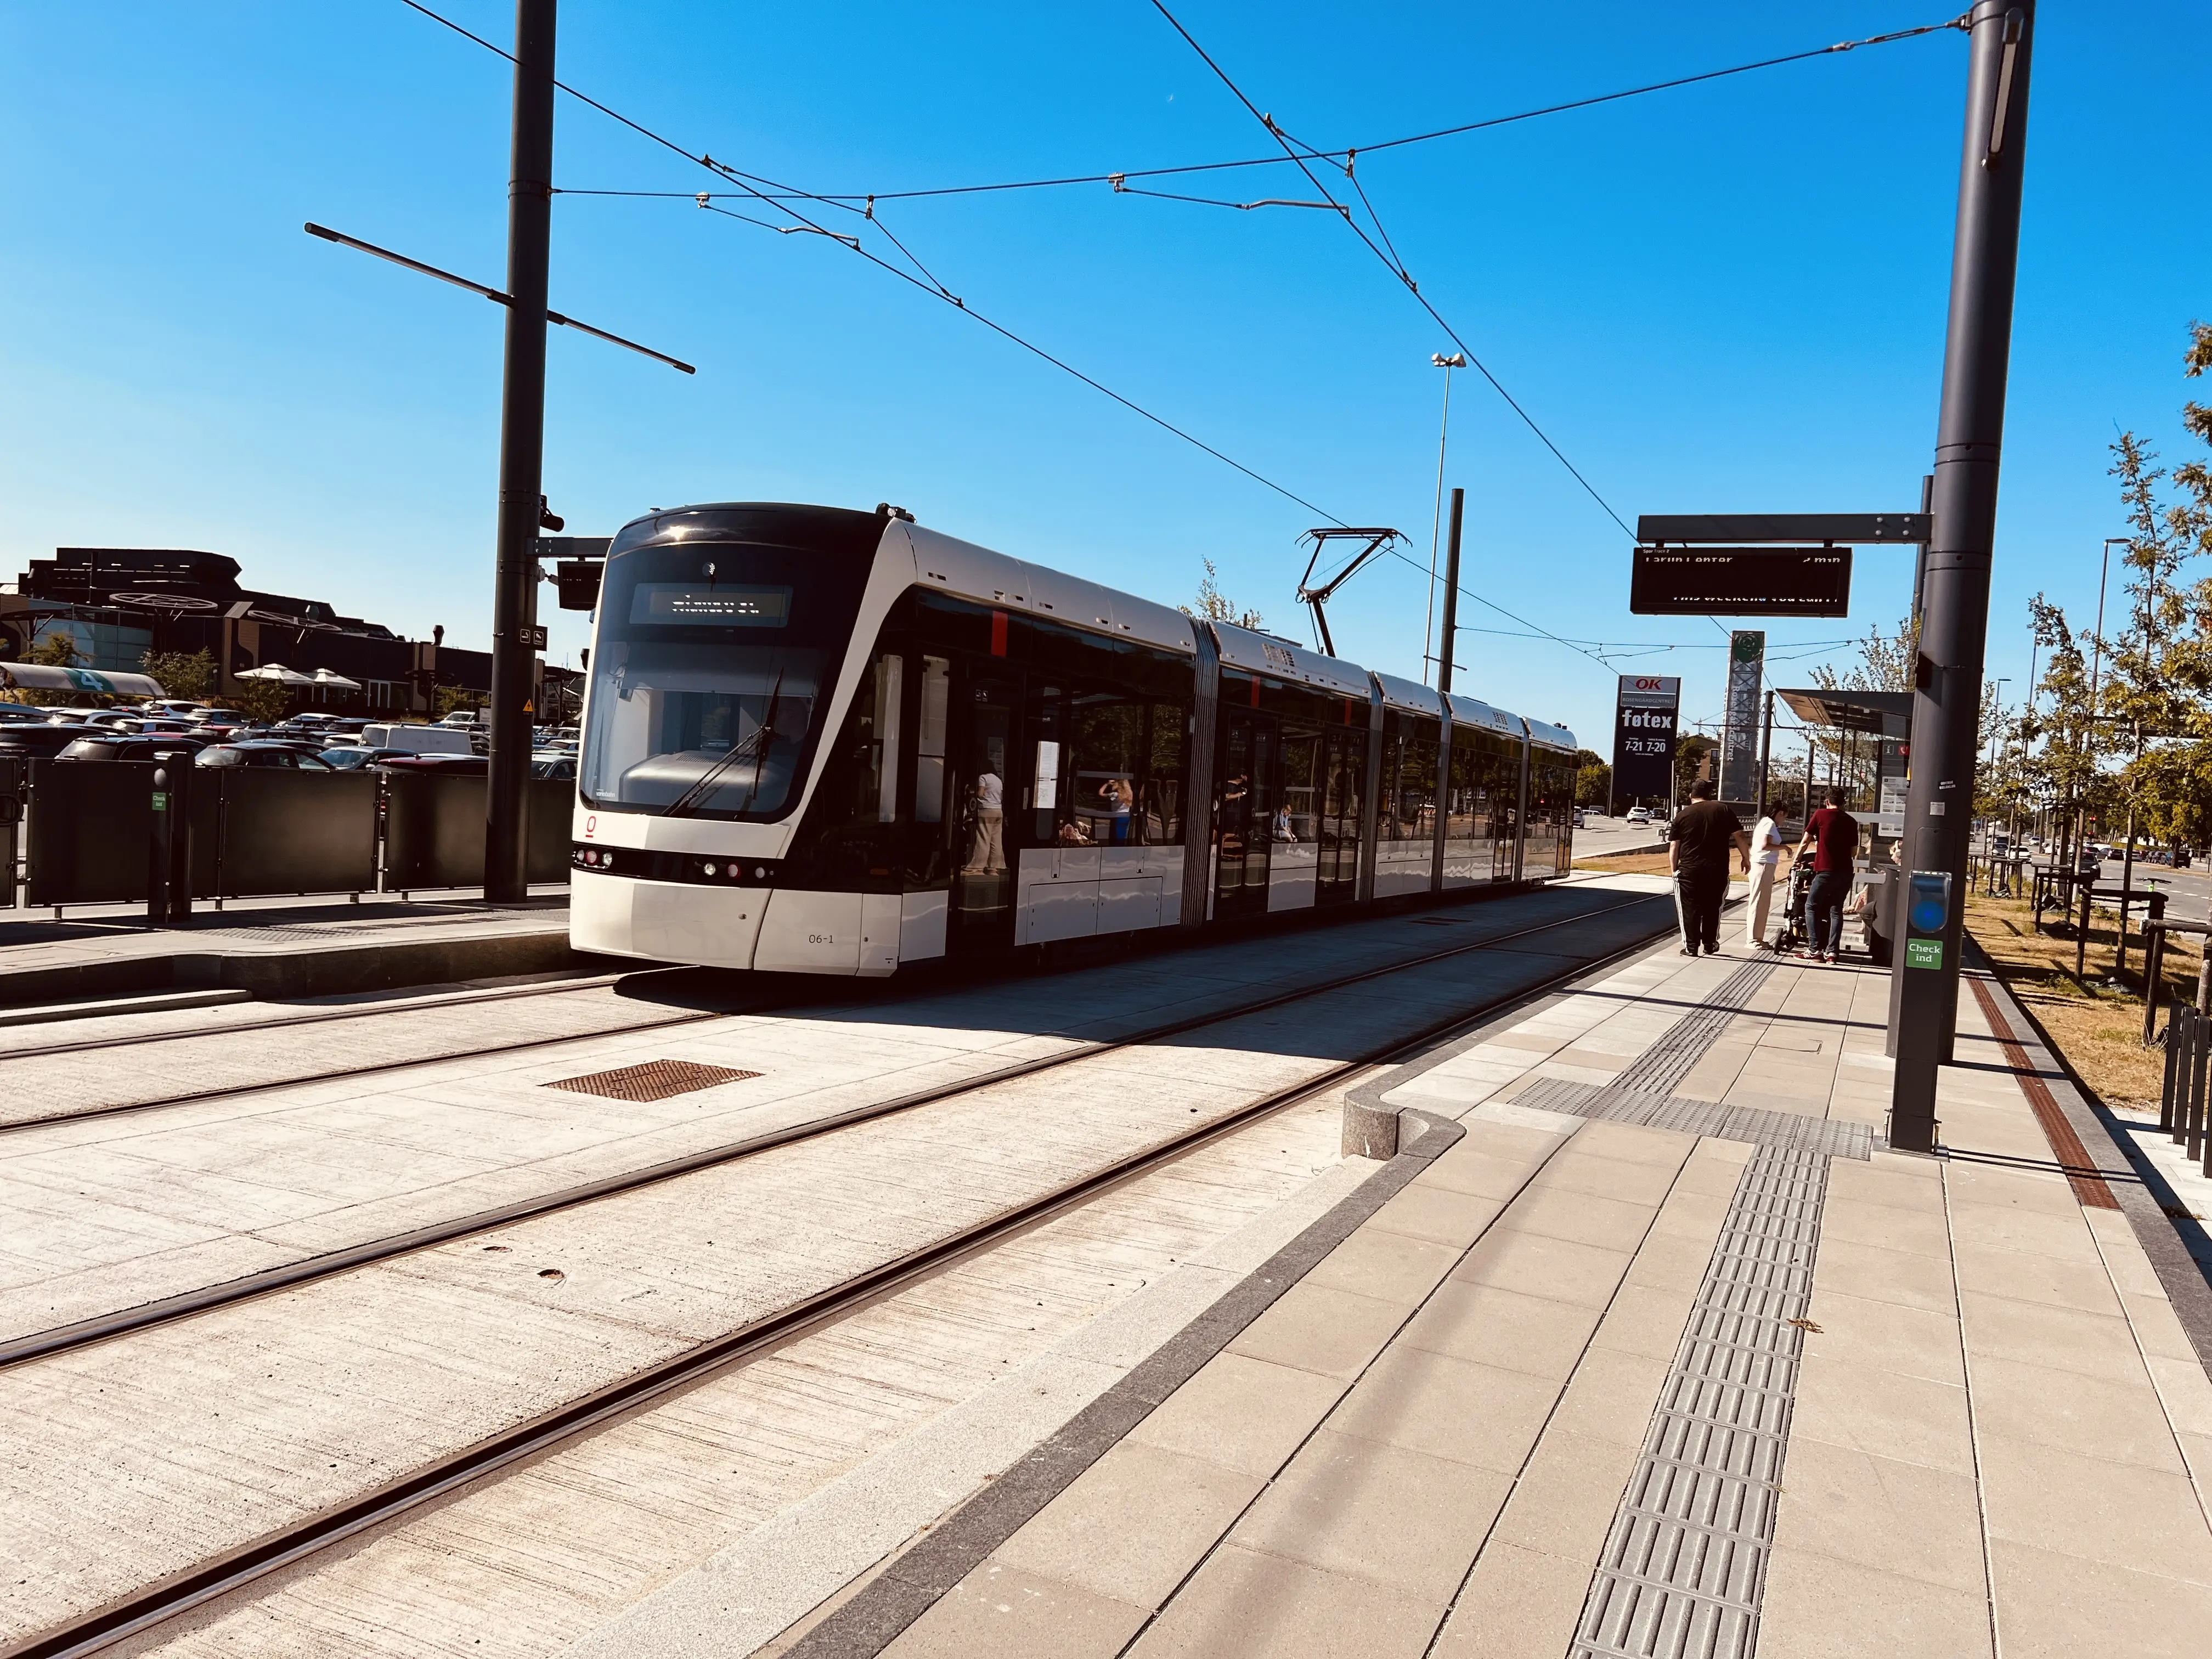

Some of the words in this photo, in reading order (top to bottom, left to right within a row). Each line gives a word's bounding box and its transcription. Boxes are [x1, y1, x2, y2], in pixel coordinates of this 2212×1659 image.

[81, 672, 104, 691] 4
[1636, 679, 1663, 690] OK
[1622, 709, 1672, 729] føtex
[1625, 741, 1643, 751] 7-21
[1646, 742, 1666, 752] 7-20
[809, 934, 834, 944] 06-1
[1909, 943, 1940, 953] Check
[1915, 953, 1933, 962] ind
